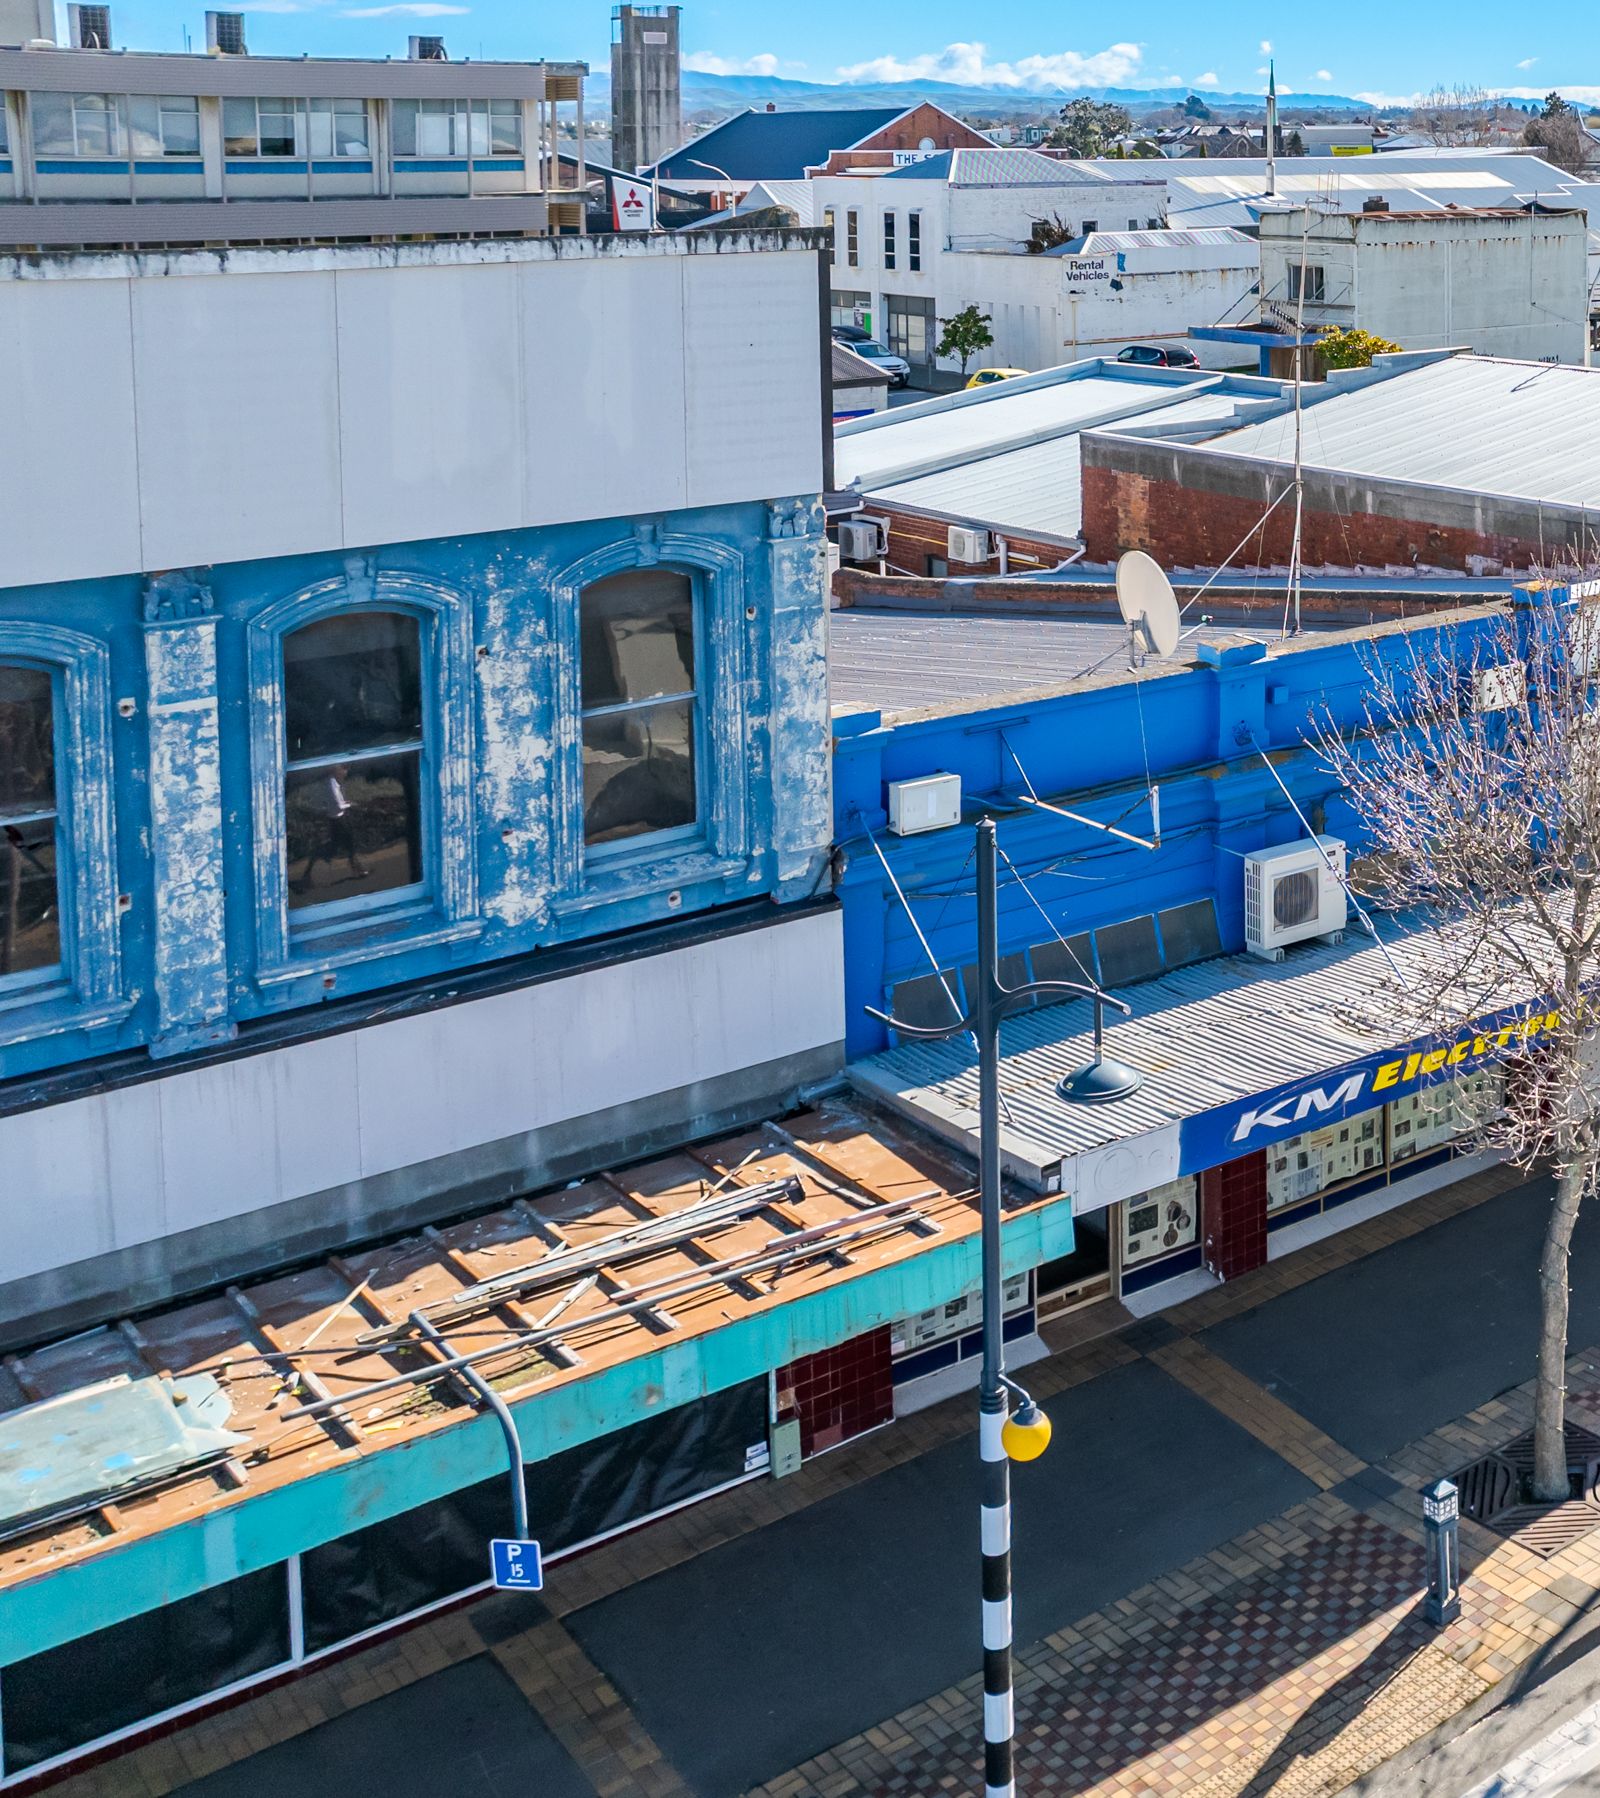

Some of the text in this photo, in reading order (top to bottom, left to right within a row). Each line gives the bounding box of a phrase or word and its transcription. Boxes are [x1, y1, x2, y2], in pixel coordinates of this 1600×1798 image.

[896, 154, 918, 165] THE
[1070, 260, 1104, 270] Rental
[1066, 271, 1109, 281] Vehicles
[1232, 1072, 1366, 1142] KM
[507, 1544, 521, 1562] P
[511, 1563, 524, 1577] 15
